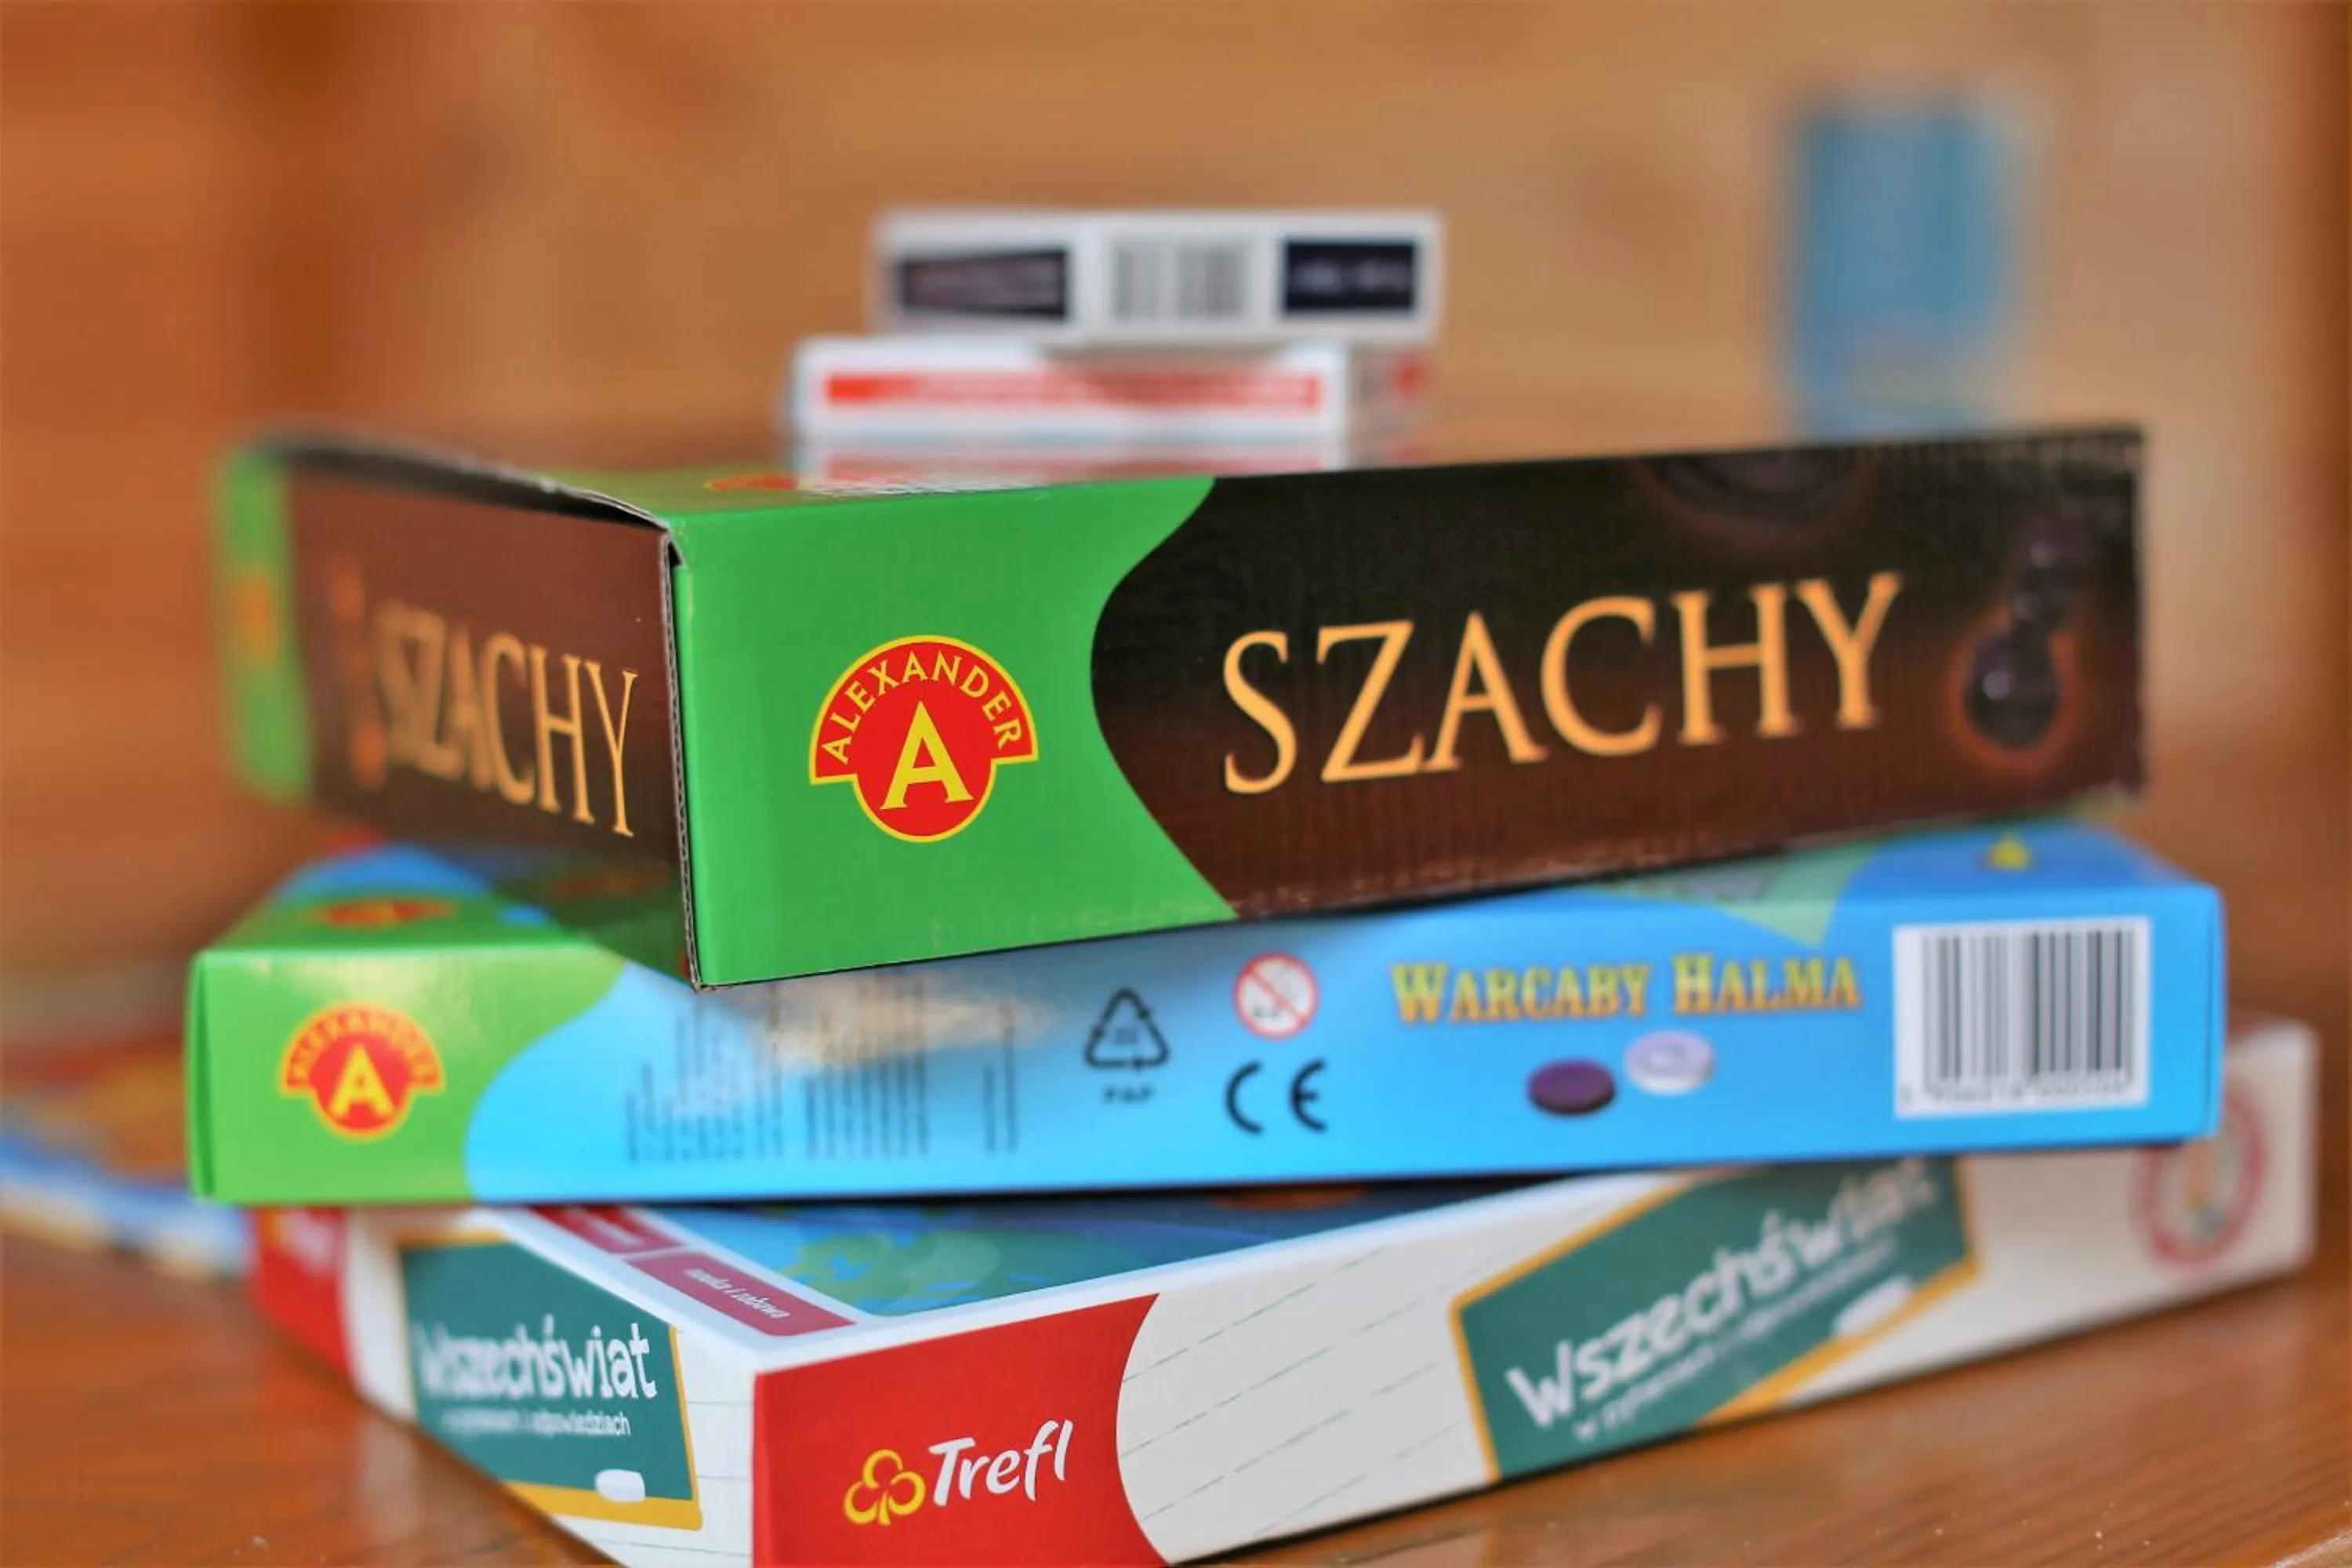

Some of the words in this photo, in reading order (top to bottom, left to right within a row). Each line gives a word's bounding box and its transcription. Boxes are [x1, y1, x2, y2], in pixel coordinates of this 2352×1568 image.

[376, 599, 637, 838] SZACHY
[820, 649, 1022, 765] ALEXANDER
[1222, 572, 1903, 794] SZACHY
[880, 700, 974, 810] A
[1671, 952, 1861, 1014] HALMA
[329, 1041, 394, 1116] A
[1225, 1058, 1330, 1137] CE
[411, 1312, 659, 1399] Wszechświat
[928, 1418, 1074, 1506] Trefl
